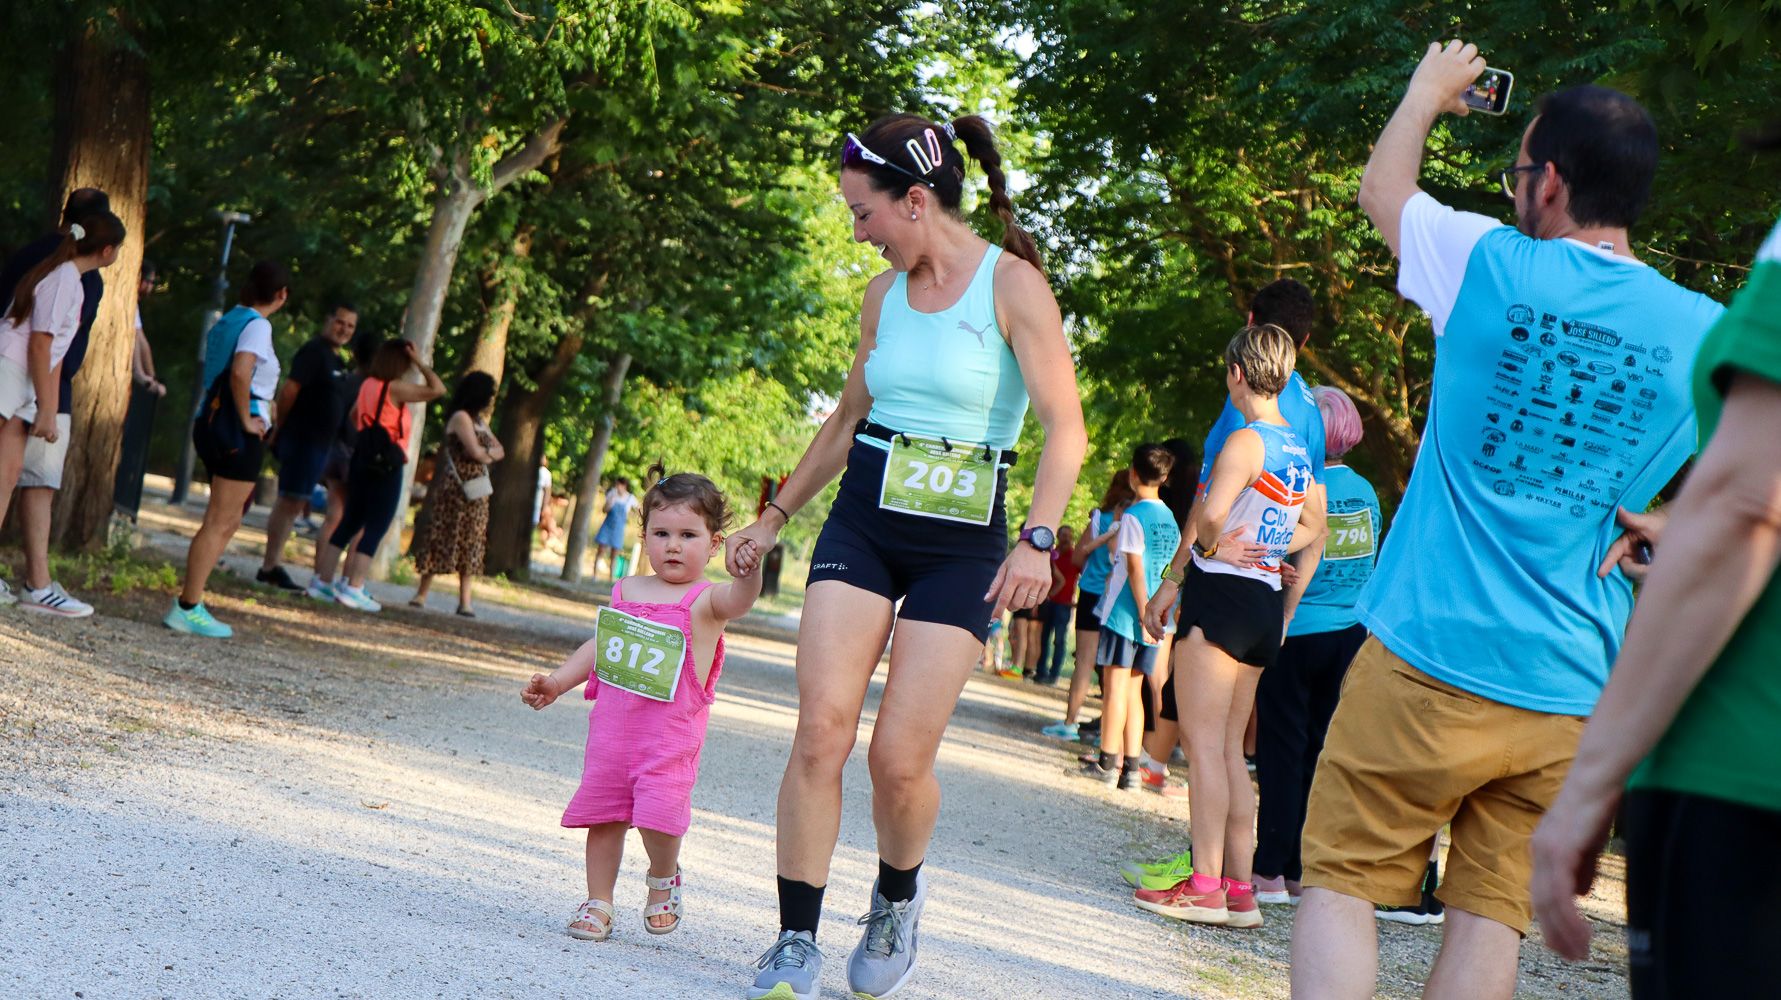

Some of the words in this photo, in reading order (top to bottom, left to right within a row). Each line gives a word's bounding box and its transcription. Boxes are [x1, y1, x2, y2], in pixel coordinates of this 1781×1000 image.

[1588, 330, 1617, 346] SILLERO
[903, 461, 978, 498] 203
[1336, 526, 1368, 546] 796
[605, 636, 666, 676] 812
